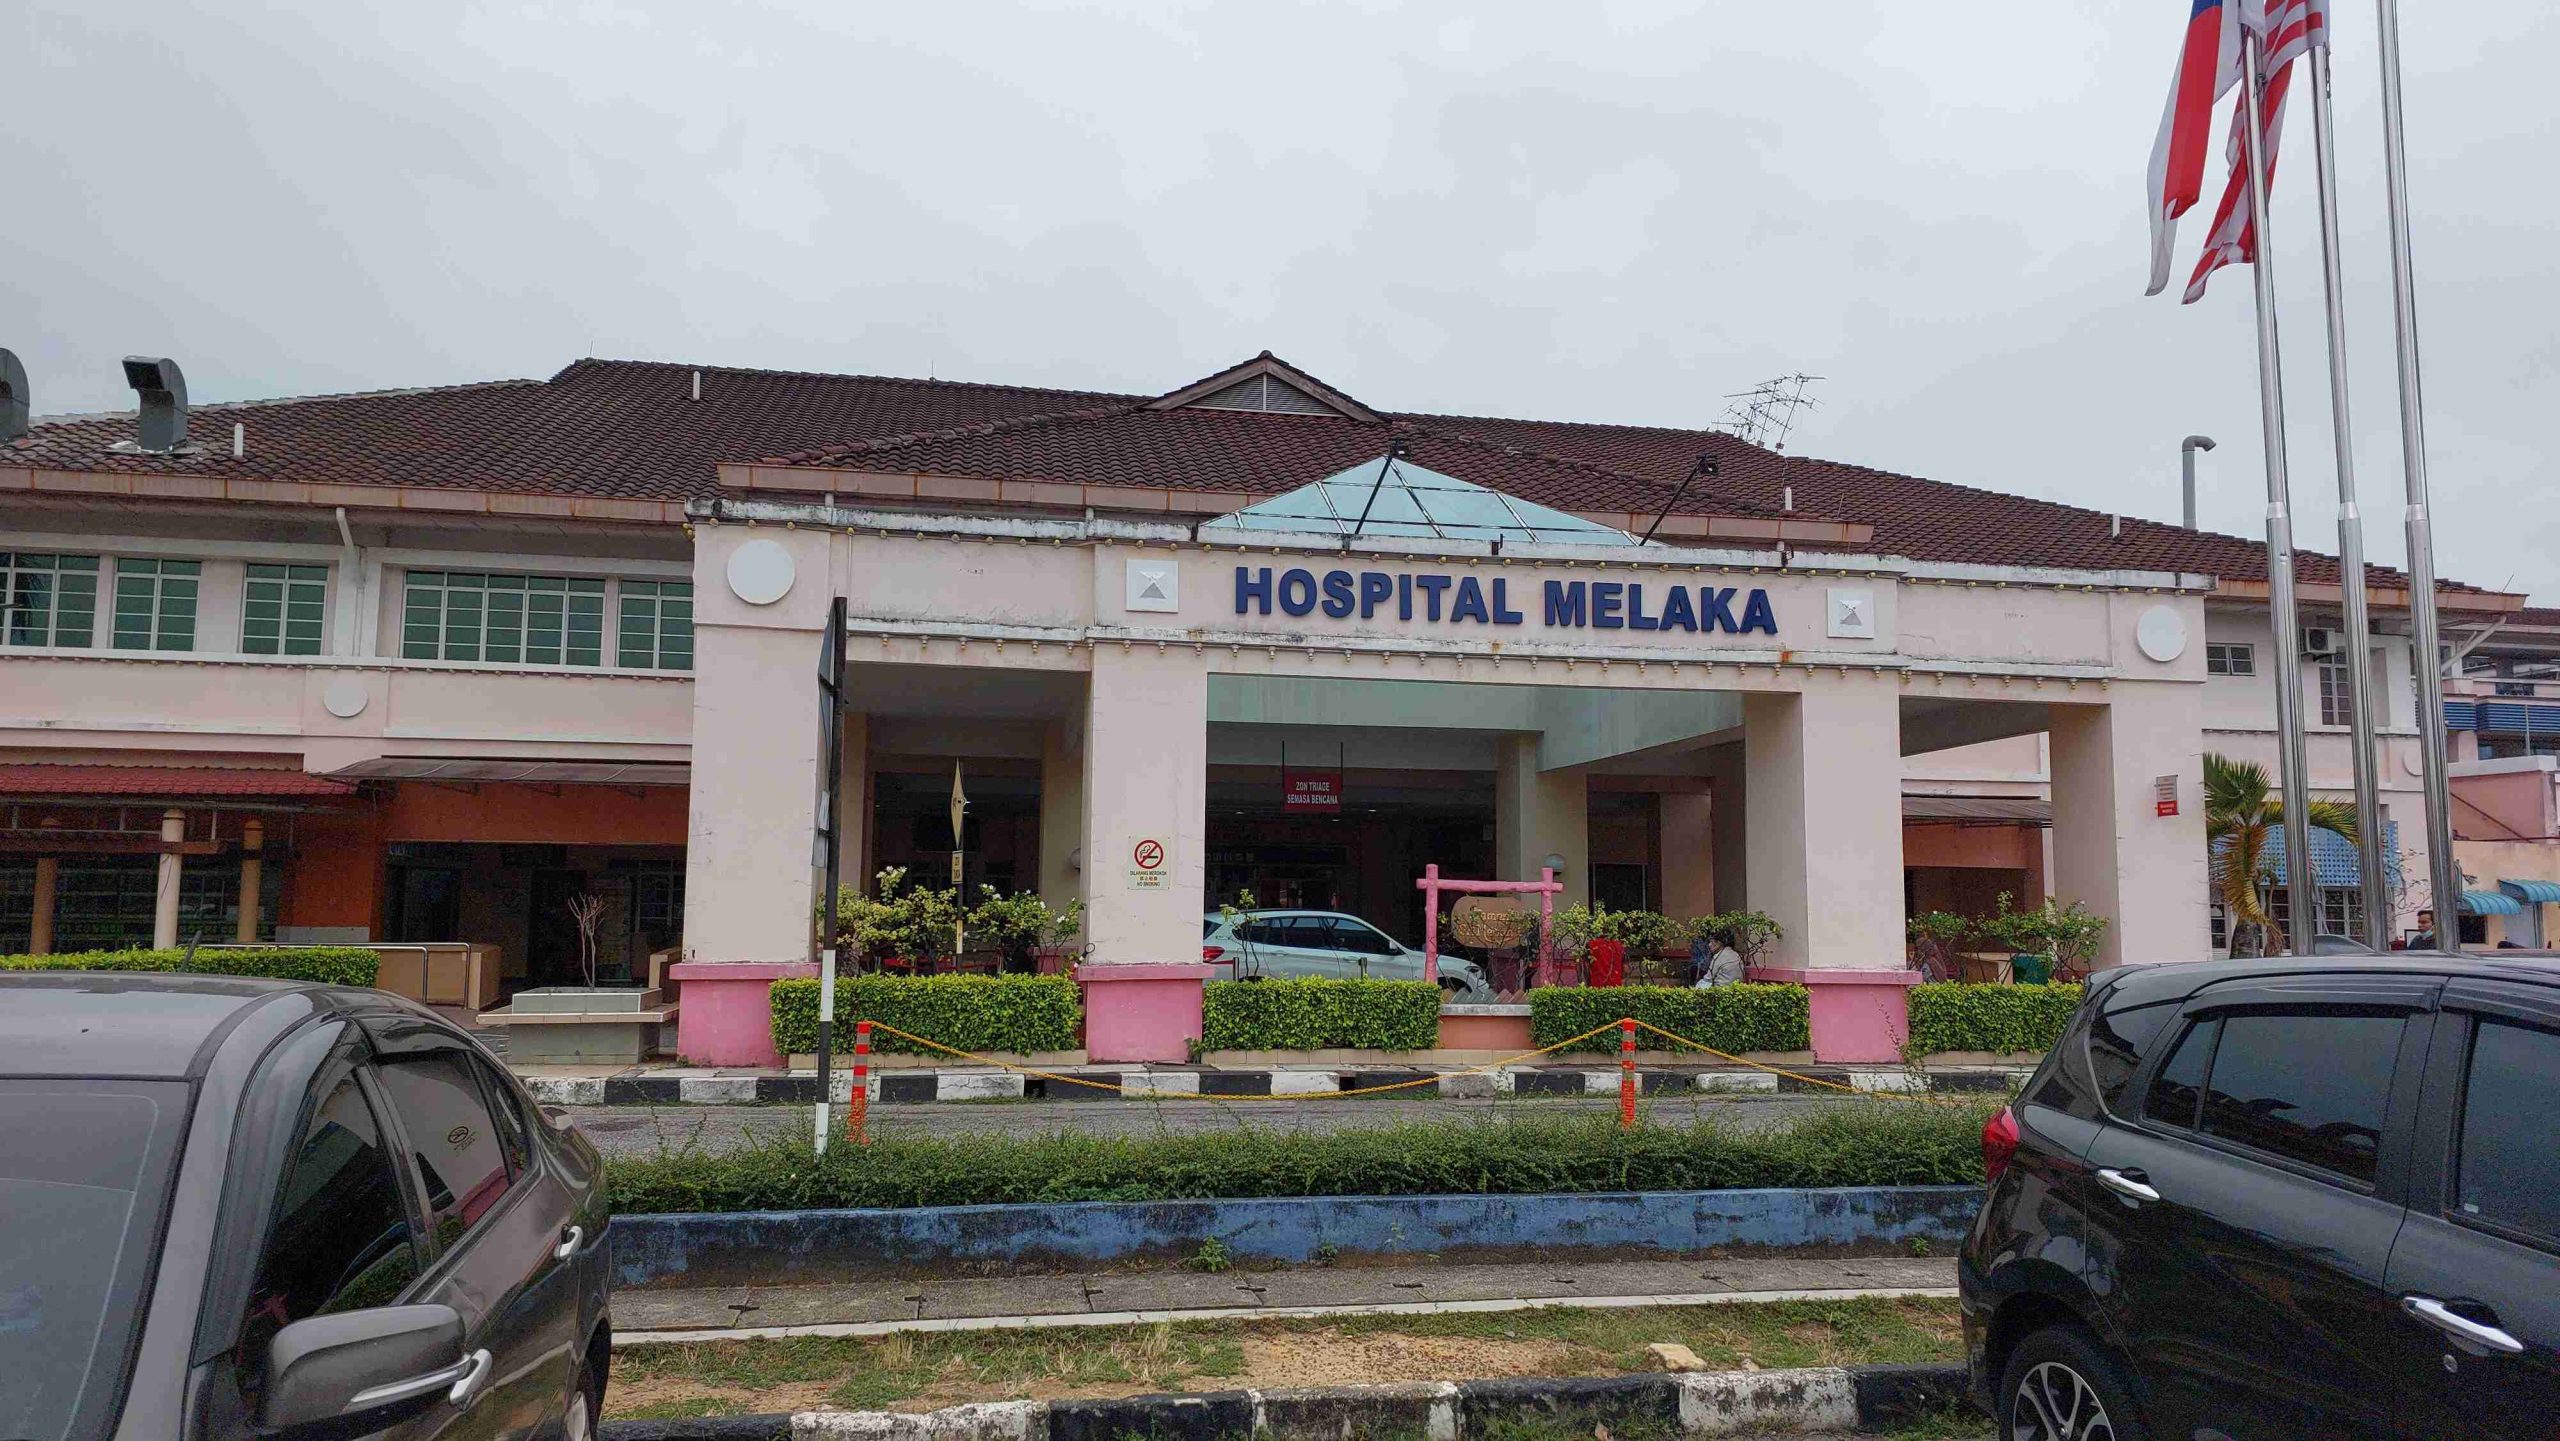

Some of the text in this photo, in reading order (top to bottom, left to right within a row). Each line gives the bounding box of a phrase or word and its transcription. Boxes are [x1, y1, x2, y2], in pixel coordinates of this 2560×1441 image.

[1235, 565, 1778, 635] HOSPITAL MELAKA
[1296, 781, 1330, 792] ZON TRIAGE
[1287, 794, 1338, 805] SEMASA BENCANA
